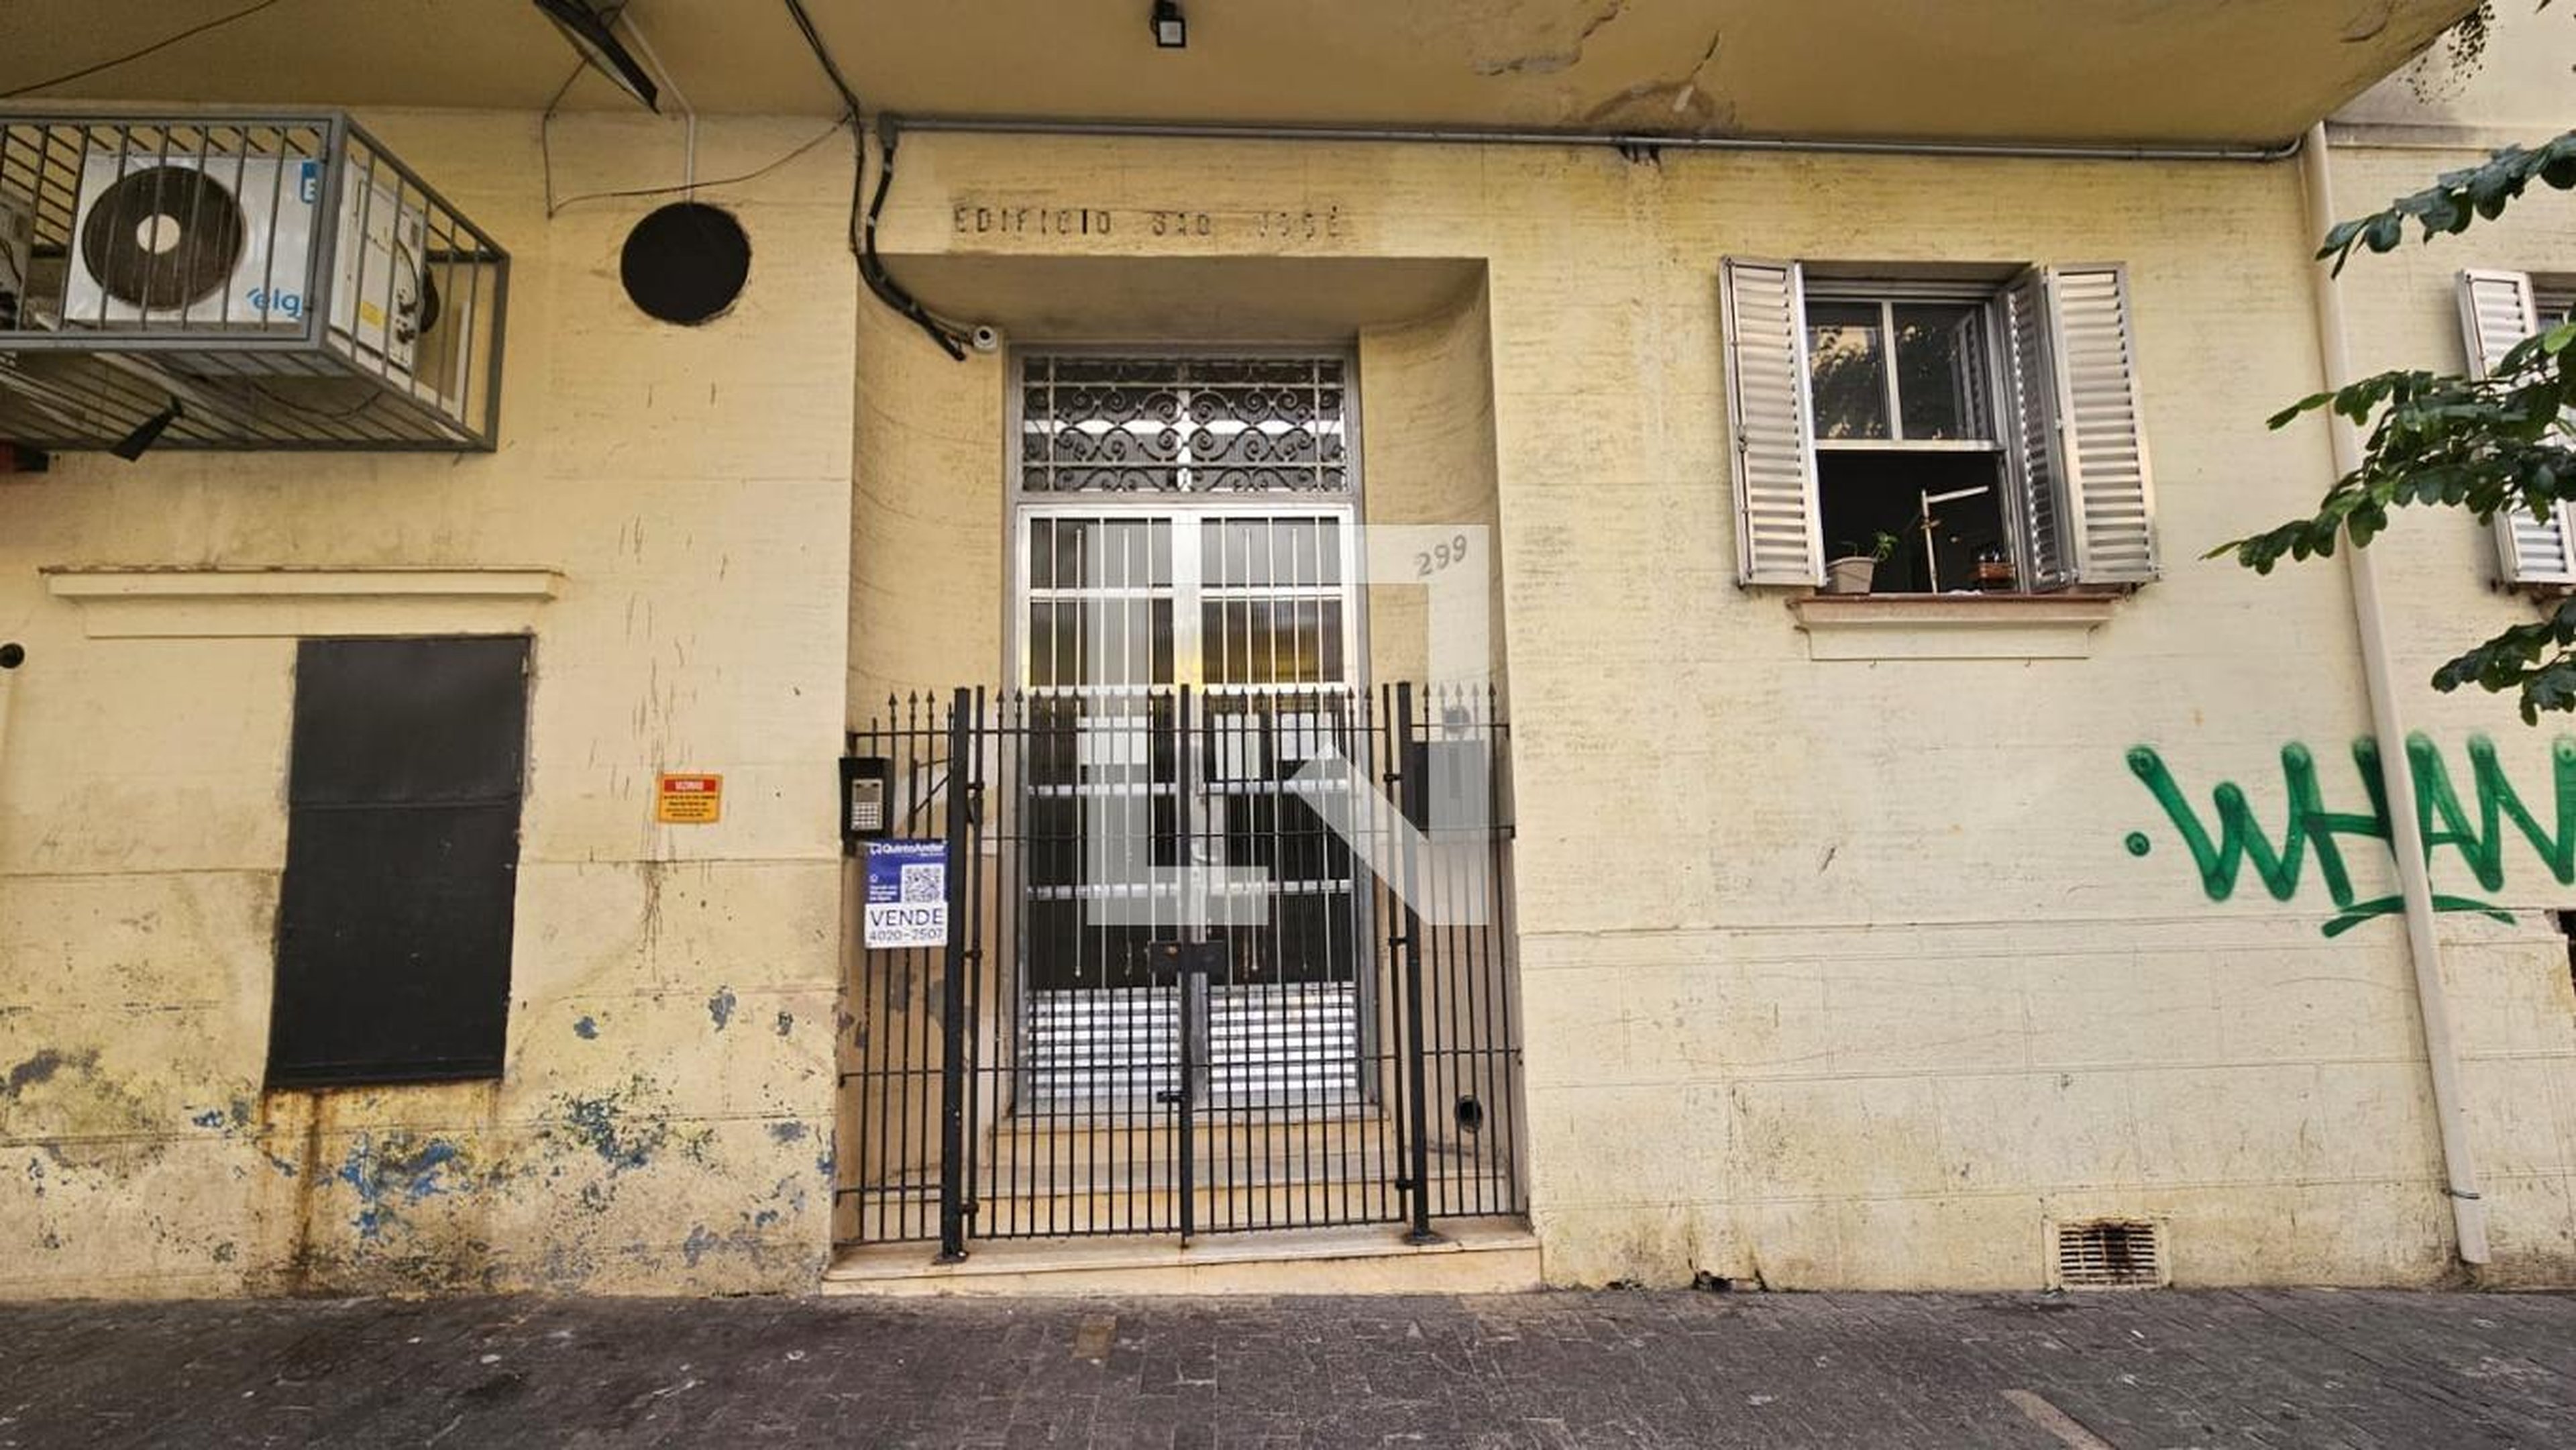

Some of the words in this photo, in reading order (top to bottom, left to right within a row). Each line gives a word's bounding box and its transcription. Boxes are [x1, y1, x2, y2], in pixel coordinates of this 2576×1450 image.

[955, 206, 1111, 235] EDIFICIO
[1414, 534, 1467, 578] 299
[870, 908, 944, 926] VENDE
